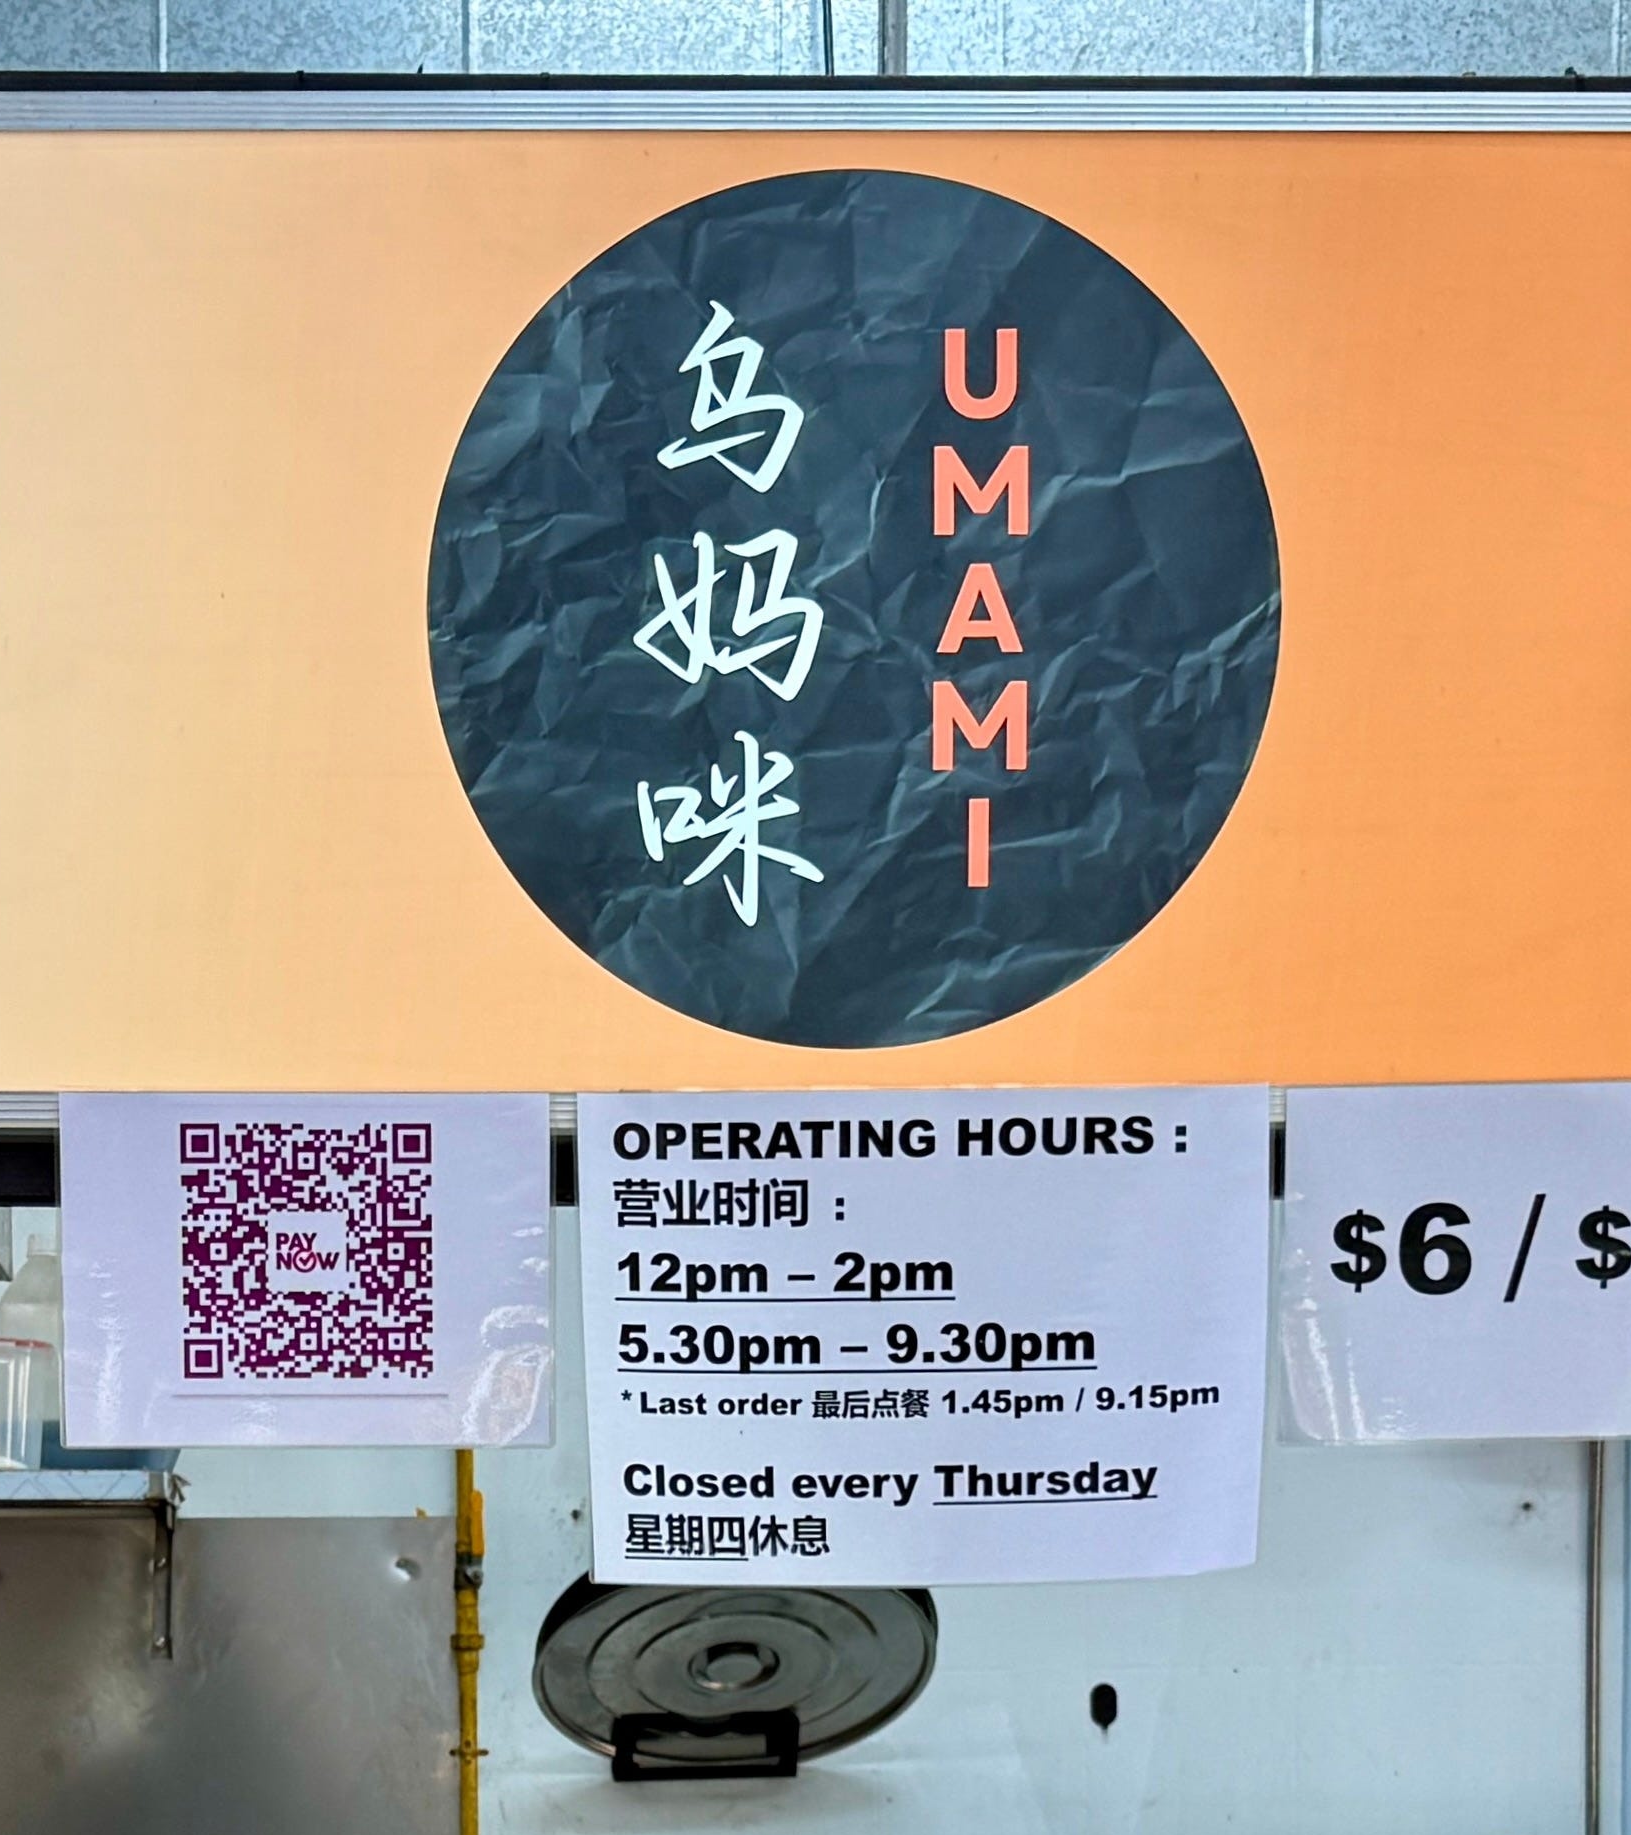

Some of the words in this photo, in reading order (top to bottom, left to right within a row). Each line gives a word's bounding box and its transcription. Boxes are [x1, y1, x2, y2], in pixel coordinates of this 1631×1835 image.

[633, 300, 825, 928] 乌妈咪
[931, 327, 1031, 888] UMAMI
[613, 1119, 936, 1160] OPERATING
[957, 1116, 1154, 1157] HOURS
[613, 1179, 809, 1228] 营业时间
[276, 1232, 317, 1251] PAY
[276, 1251, 340, 1273] NOW
[1330, 1201, 1472, 1295] $6
[617, 1252, 768, 1299] 12pm
[833, 1251, 954, 1299] 2pm
[618, 1323, 821, 1372] 5.30pm
[886, 1322, 1096, 1370] 9.30pm
[640, 1391, 707, 1416] Last
[718, 1392, 801, 1416] order
[812, 1389, 929, 1420] 最后点餐
[942, 1390, 1064, 1418] 1.45pm
[1096, 1384, 1220, 1412] 9.15pm
[623, 1463, 773, 1499] Closed
[792, 1469, 918, 1506] every
[933, 1462, 1157, 1500] Thursday
[625, 1513, 830, 1558] 星期四休息
